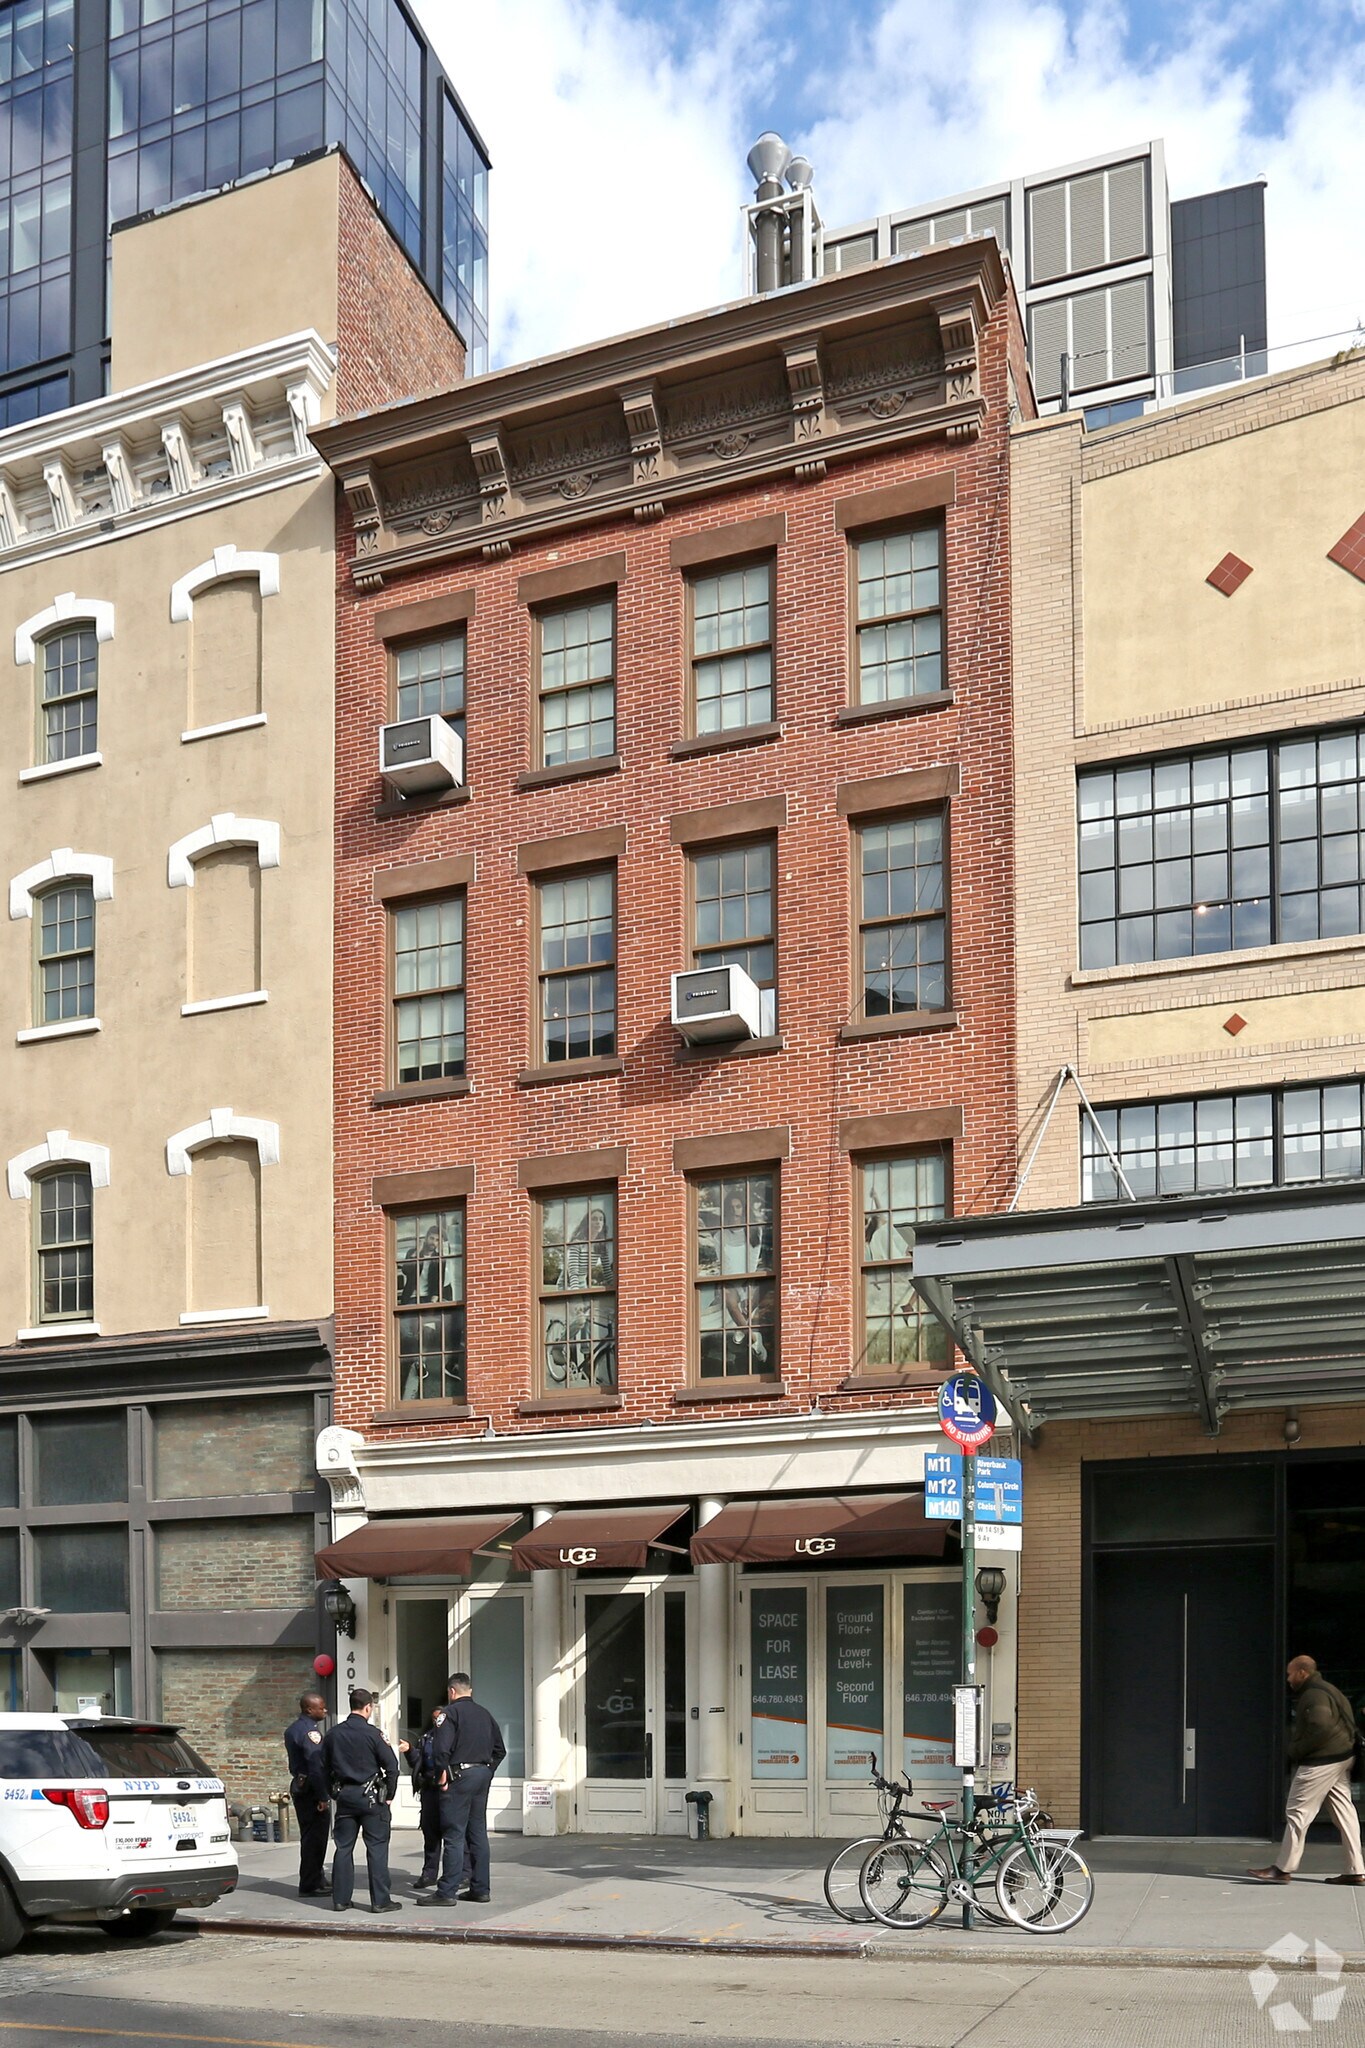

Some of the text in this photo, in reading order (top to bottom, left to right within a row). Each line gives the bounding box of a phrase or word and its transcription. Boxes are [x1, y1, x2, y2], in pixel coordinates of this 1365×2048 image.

[945, 1421, 992, 1442] NO STANDING
[927, 1457, 951, 1472] M11
[927, 1478, 957, 1495] M12
[1003, 1482, 1019, 1490] Circle
[928, 1500, 960, 1516] M14D
[795, 1537, 836, 1555] UGG
[560, 1547, 597, 1565] UGG
[759, 1613, 798, 1628] SPACE
[837, 1612, 874, 1623] Ground
[838, 1624, 872, 1635] Floor+
[766, 1640, 791, 1653] FOR
[839, 1647, 871, 1657] Lower
[837, 1659, 873, 1669] Level+
[759, 1666, 798, 1679] LEASE
[836, 1681, 874, 1692] Second
[752, 1695, 803, 1703] 646.780.4943
[842, 1693, 869, 1703] Floor
[905, 1693, 955, 1703] 646.780.494
[123, 1781, 160, 1790] NYPD
[4, 1789, 26, 1800] 5452
[173, 1811, 191, 1822] 5452
[987, 1810, 1007, 1819] NOT
